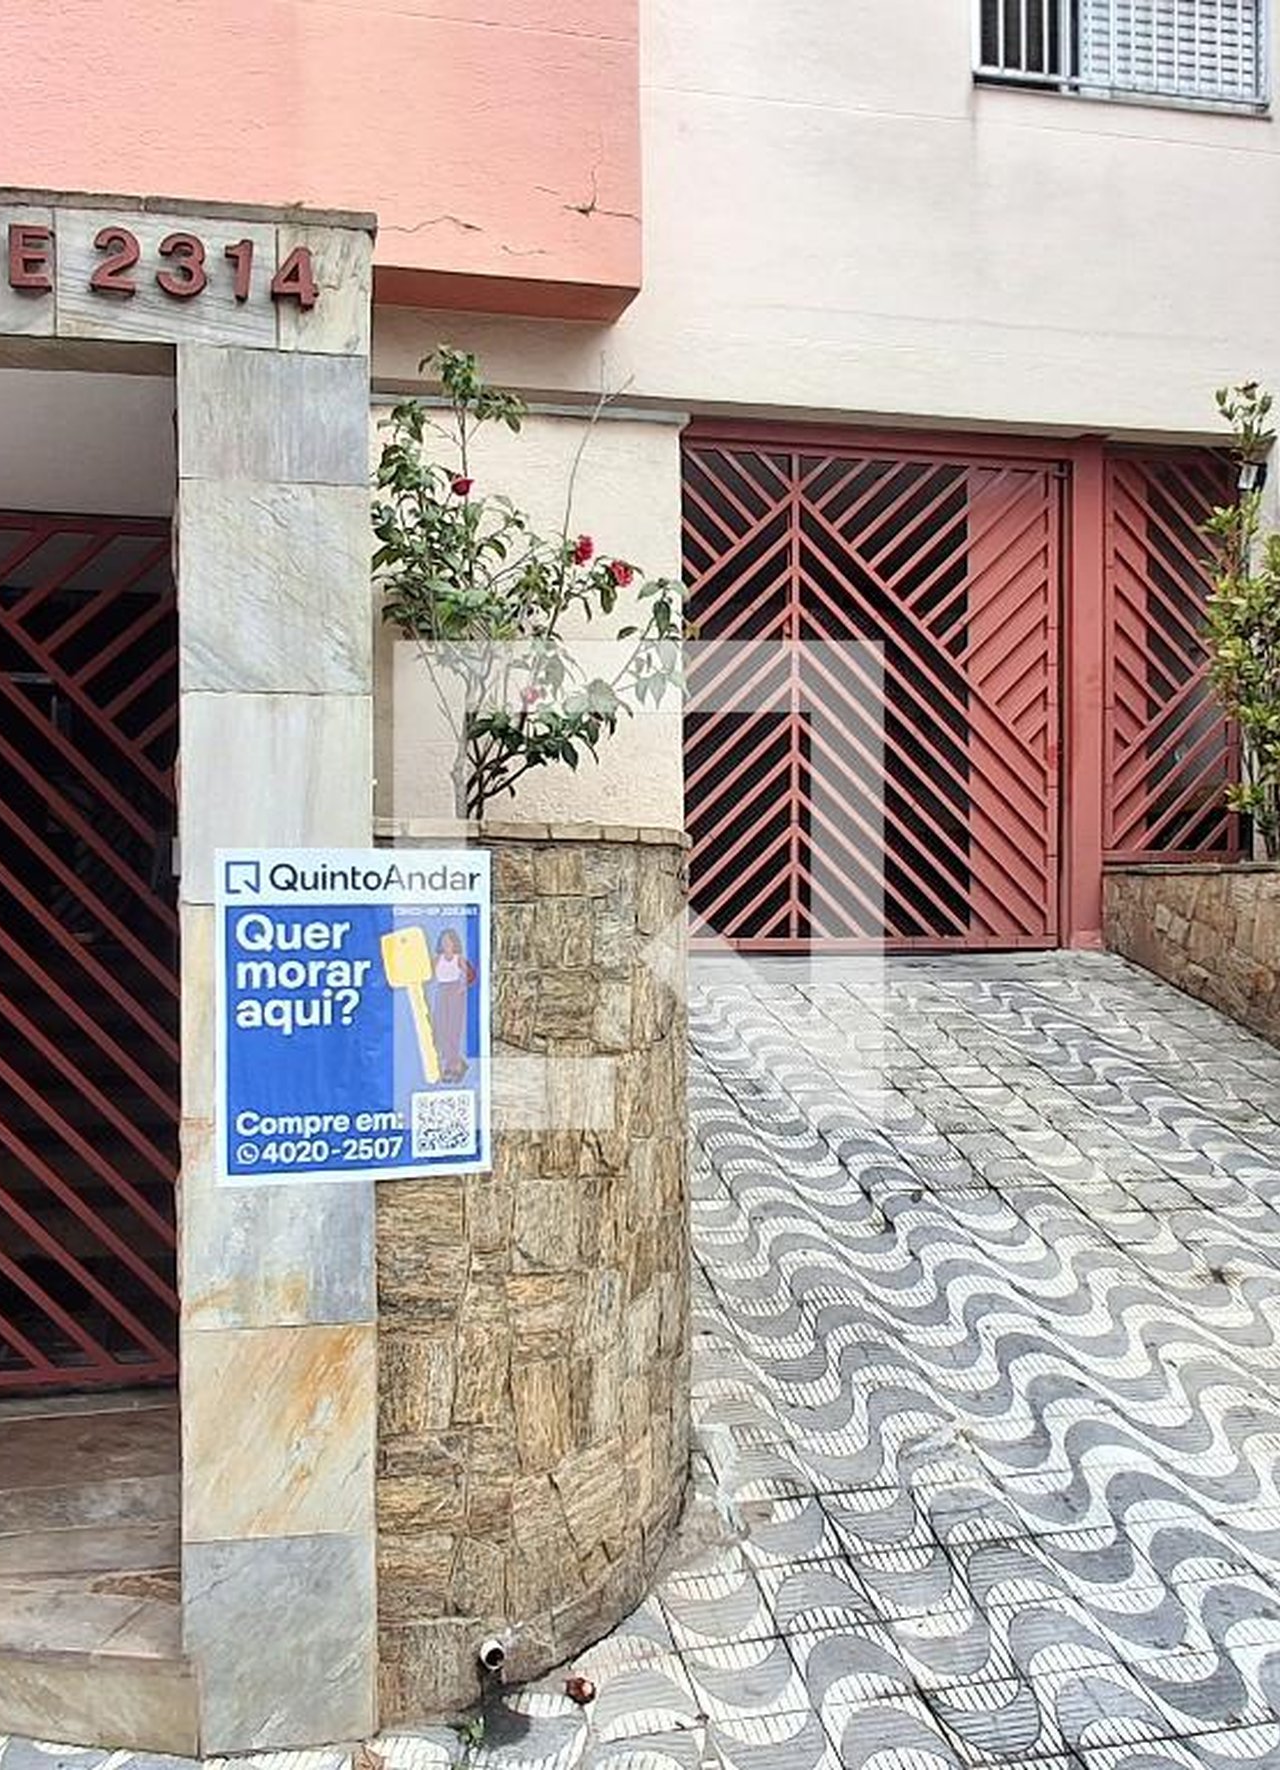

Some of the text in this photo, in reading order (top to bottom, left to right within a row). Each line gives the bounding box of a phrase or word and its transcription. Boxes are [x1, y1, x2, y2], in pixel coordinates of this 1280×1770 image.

[90, 226, 319, 308] 2314
[269, 862, 480, 893] QuintoAndar
[235, 914, 350, 951] Quer
[236, 959, 370, 989] morar
[236, 989, 360, 1034] aqui?
[236, 1112, 404, 1138] Compre em:
[263, 1137, 403, 1163] 4020-2507
